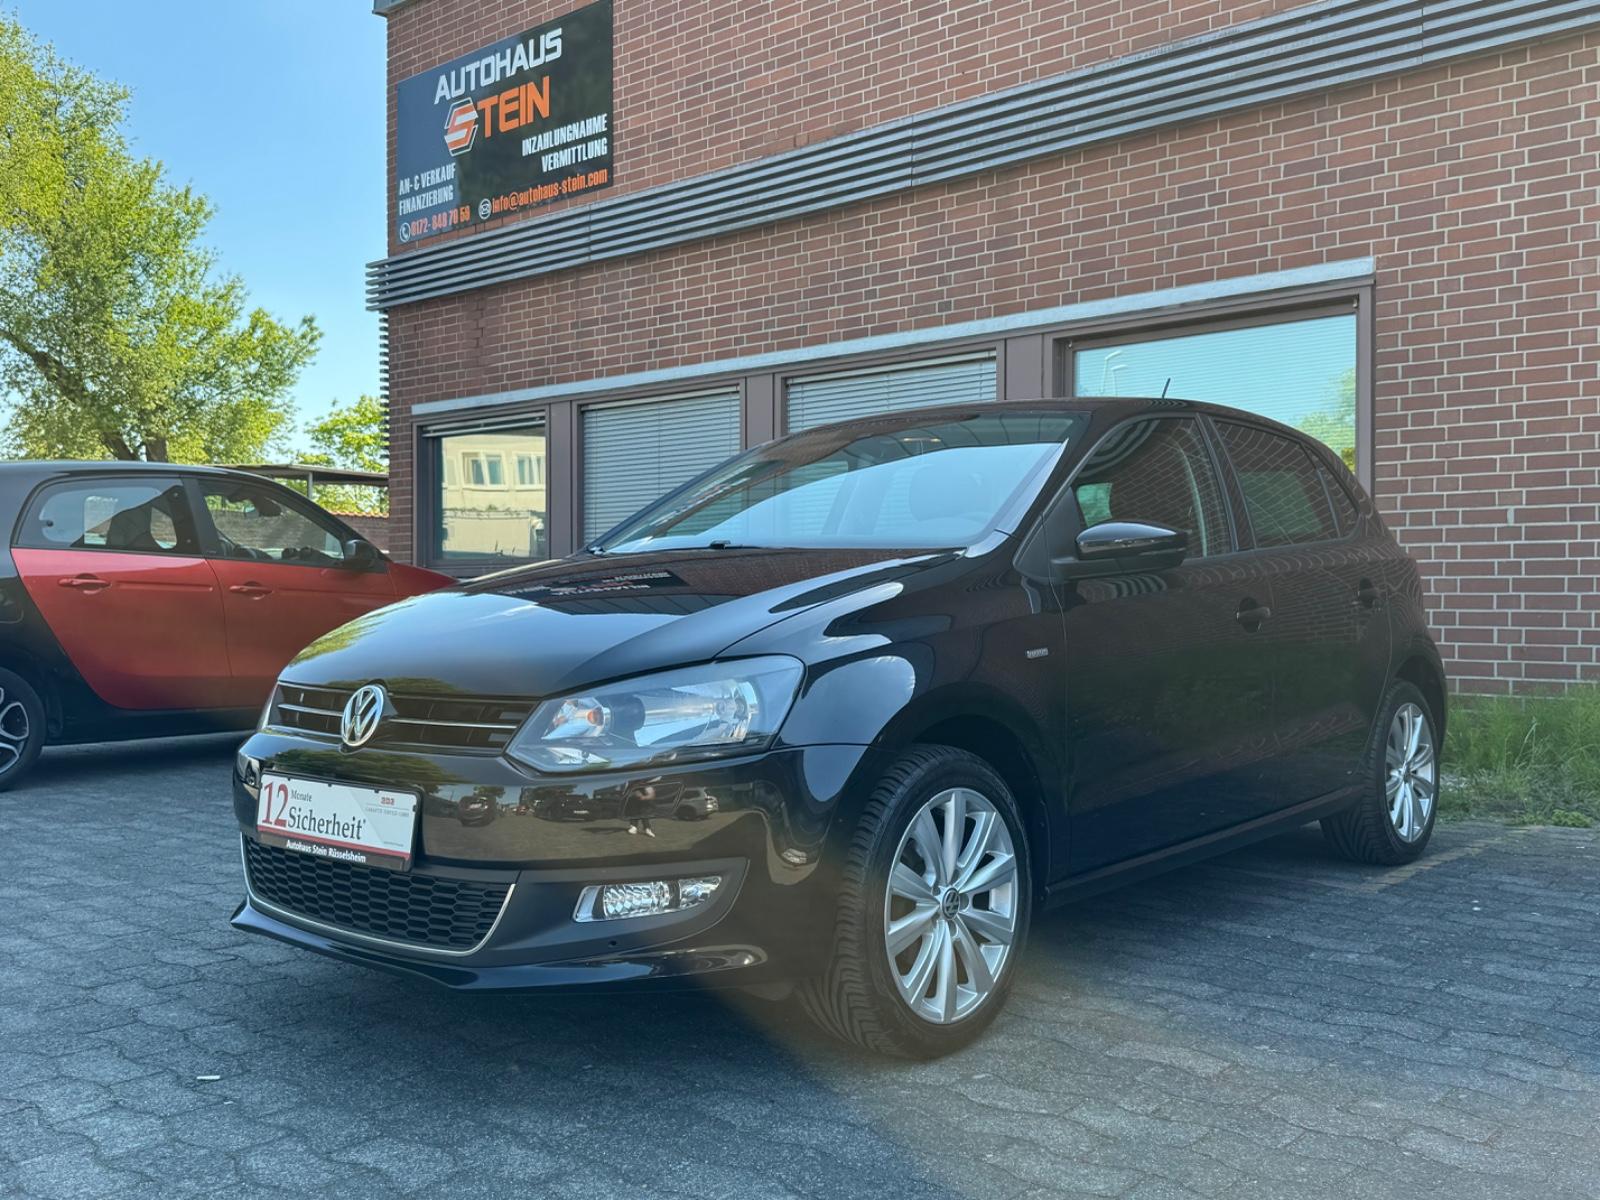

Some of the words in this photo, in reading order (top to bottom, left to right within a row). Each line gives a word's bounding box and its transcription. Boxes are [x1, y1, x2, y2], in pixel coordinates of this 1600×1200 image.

[434, 27, 562, 105] AUTOHAUS
[522, 113, 608, 157] INZAHLUNGNAHME
[541, 137, 608, 173] VERMITTLUNG
[399, 178, 413, 196] AN-
[420, 162, 457, 189] VERKAUF
[492, 168, 608, 214] info@autohaus-stein.com
[399, 184, 454, 216] FINANZIERUNG
[449, 208, 459, 227] 70
[262, 781, 289, 828] 12
[290, 789, 312, 802] Monate
[286, 839, 311, 853] Autohaus
[312, 844, 328, 857] Stein
[328, 847, 366, 863] Rüsselsheim
